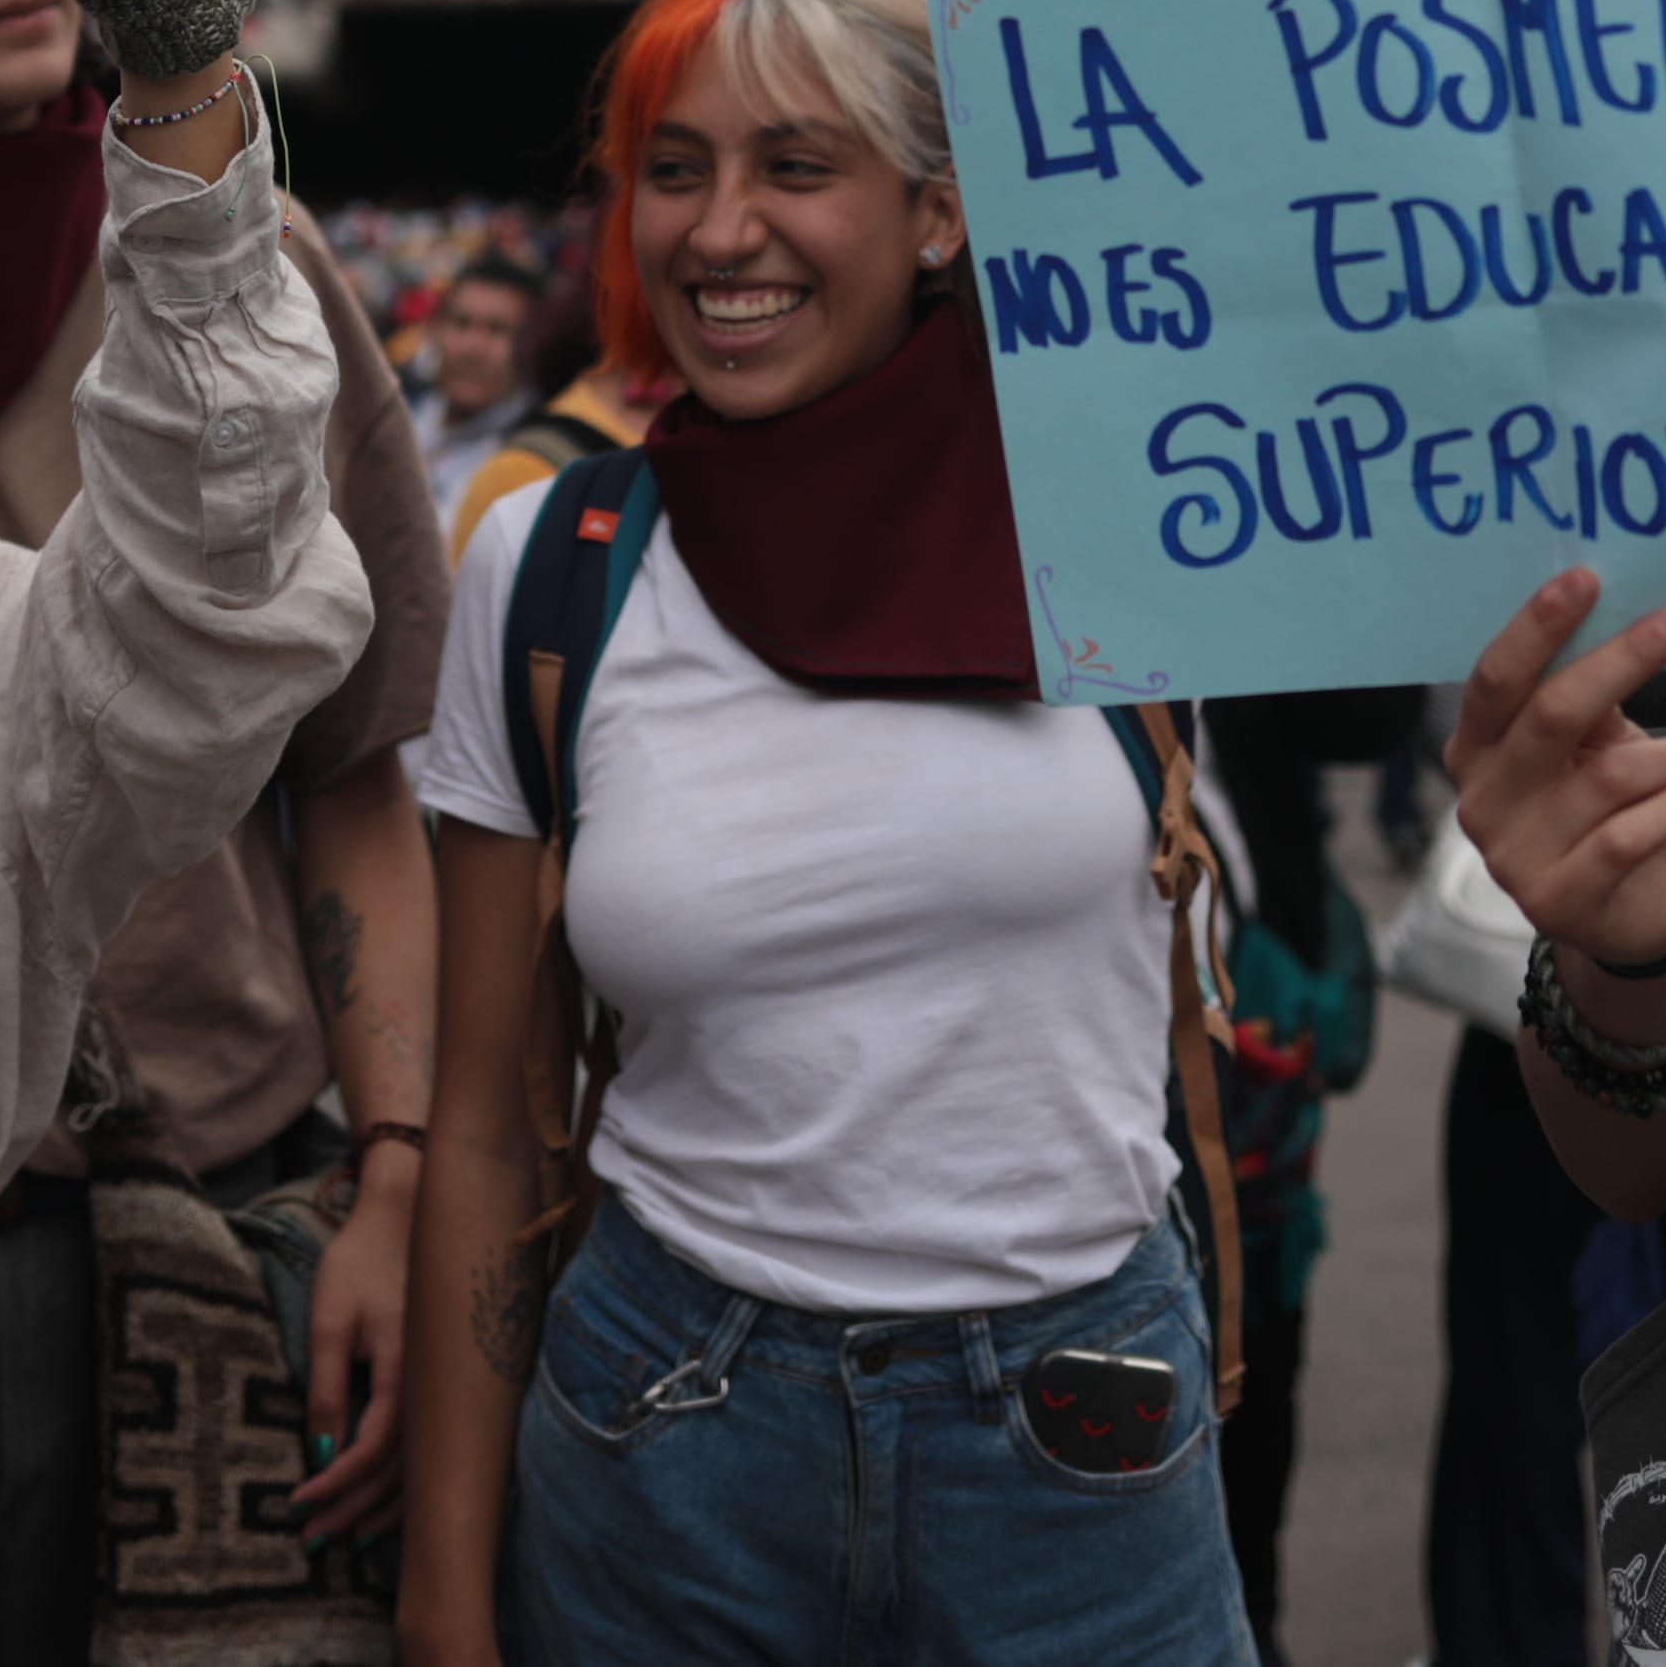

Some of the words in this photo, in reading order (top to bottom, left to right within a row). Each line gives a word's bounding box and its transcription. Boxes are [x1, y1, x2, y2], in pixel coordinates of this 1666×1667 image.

[998, 15, 1203, 189] LA
[985, 246, 1090, 354] NO
[1100, 243, 1213, 351] ES
